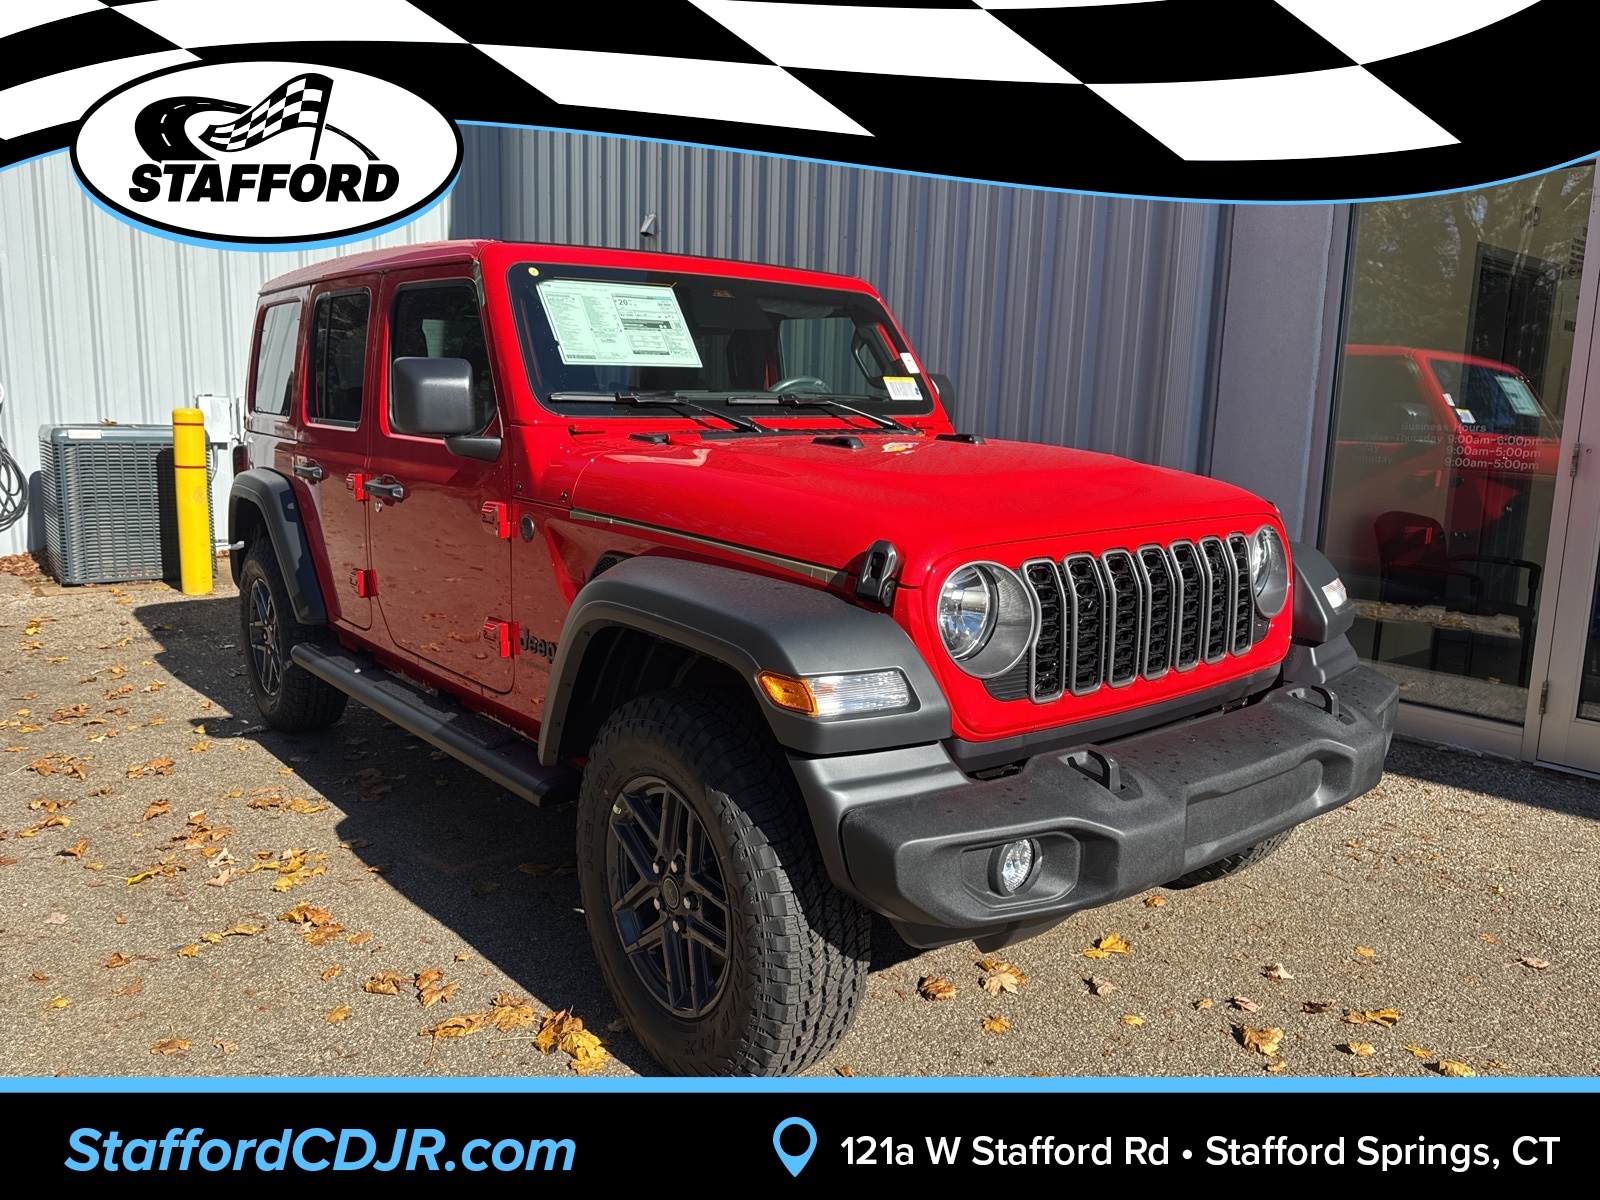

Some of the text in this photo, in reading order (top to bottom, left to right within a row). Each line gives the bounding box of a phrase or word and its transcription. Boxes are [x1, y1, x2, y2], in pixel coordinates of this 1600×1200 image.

[1401, 422, 1487, 433] Business Hours
[1446, 445, 1541, 458] 9:00am-5:00pm
[1444, 458, 1539, 470] 9:00am-5:00pm
[519, 628, 557, 664] Jeep
